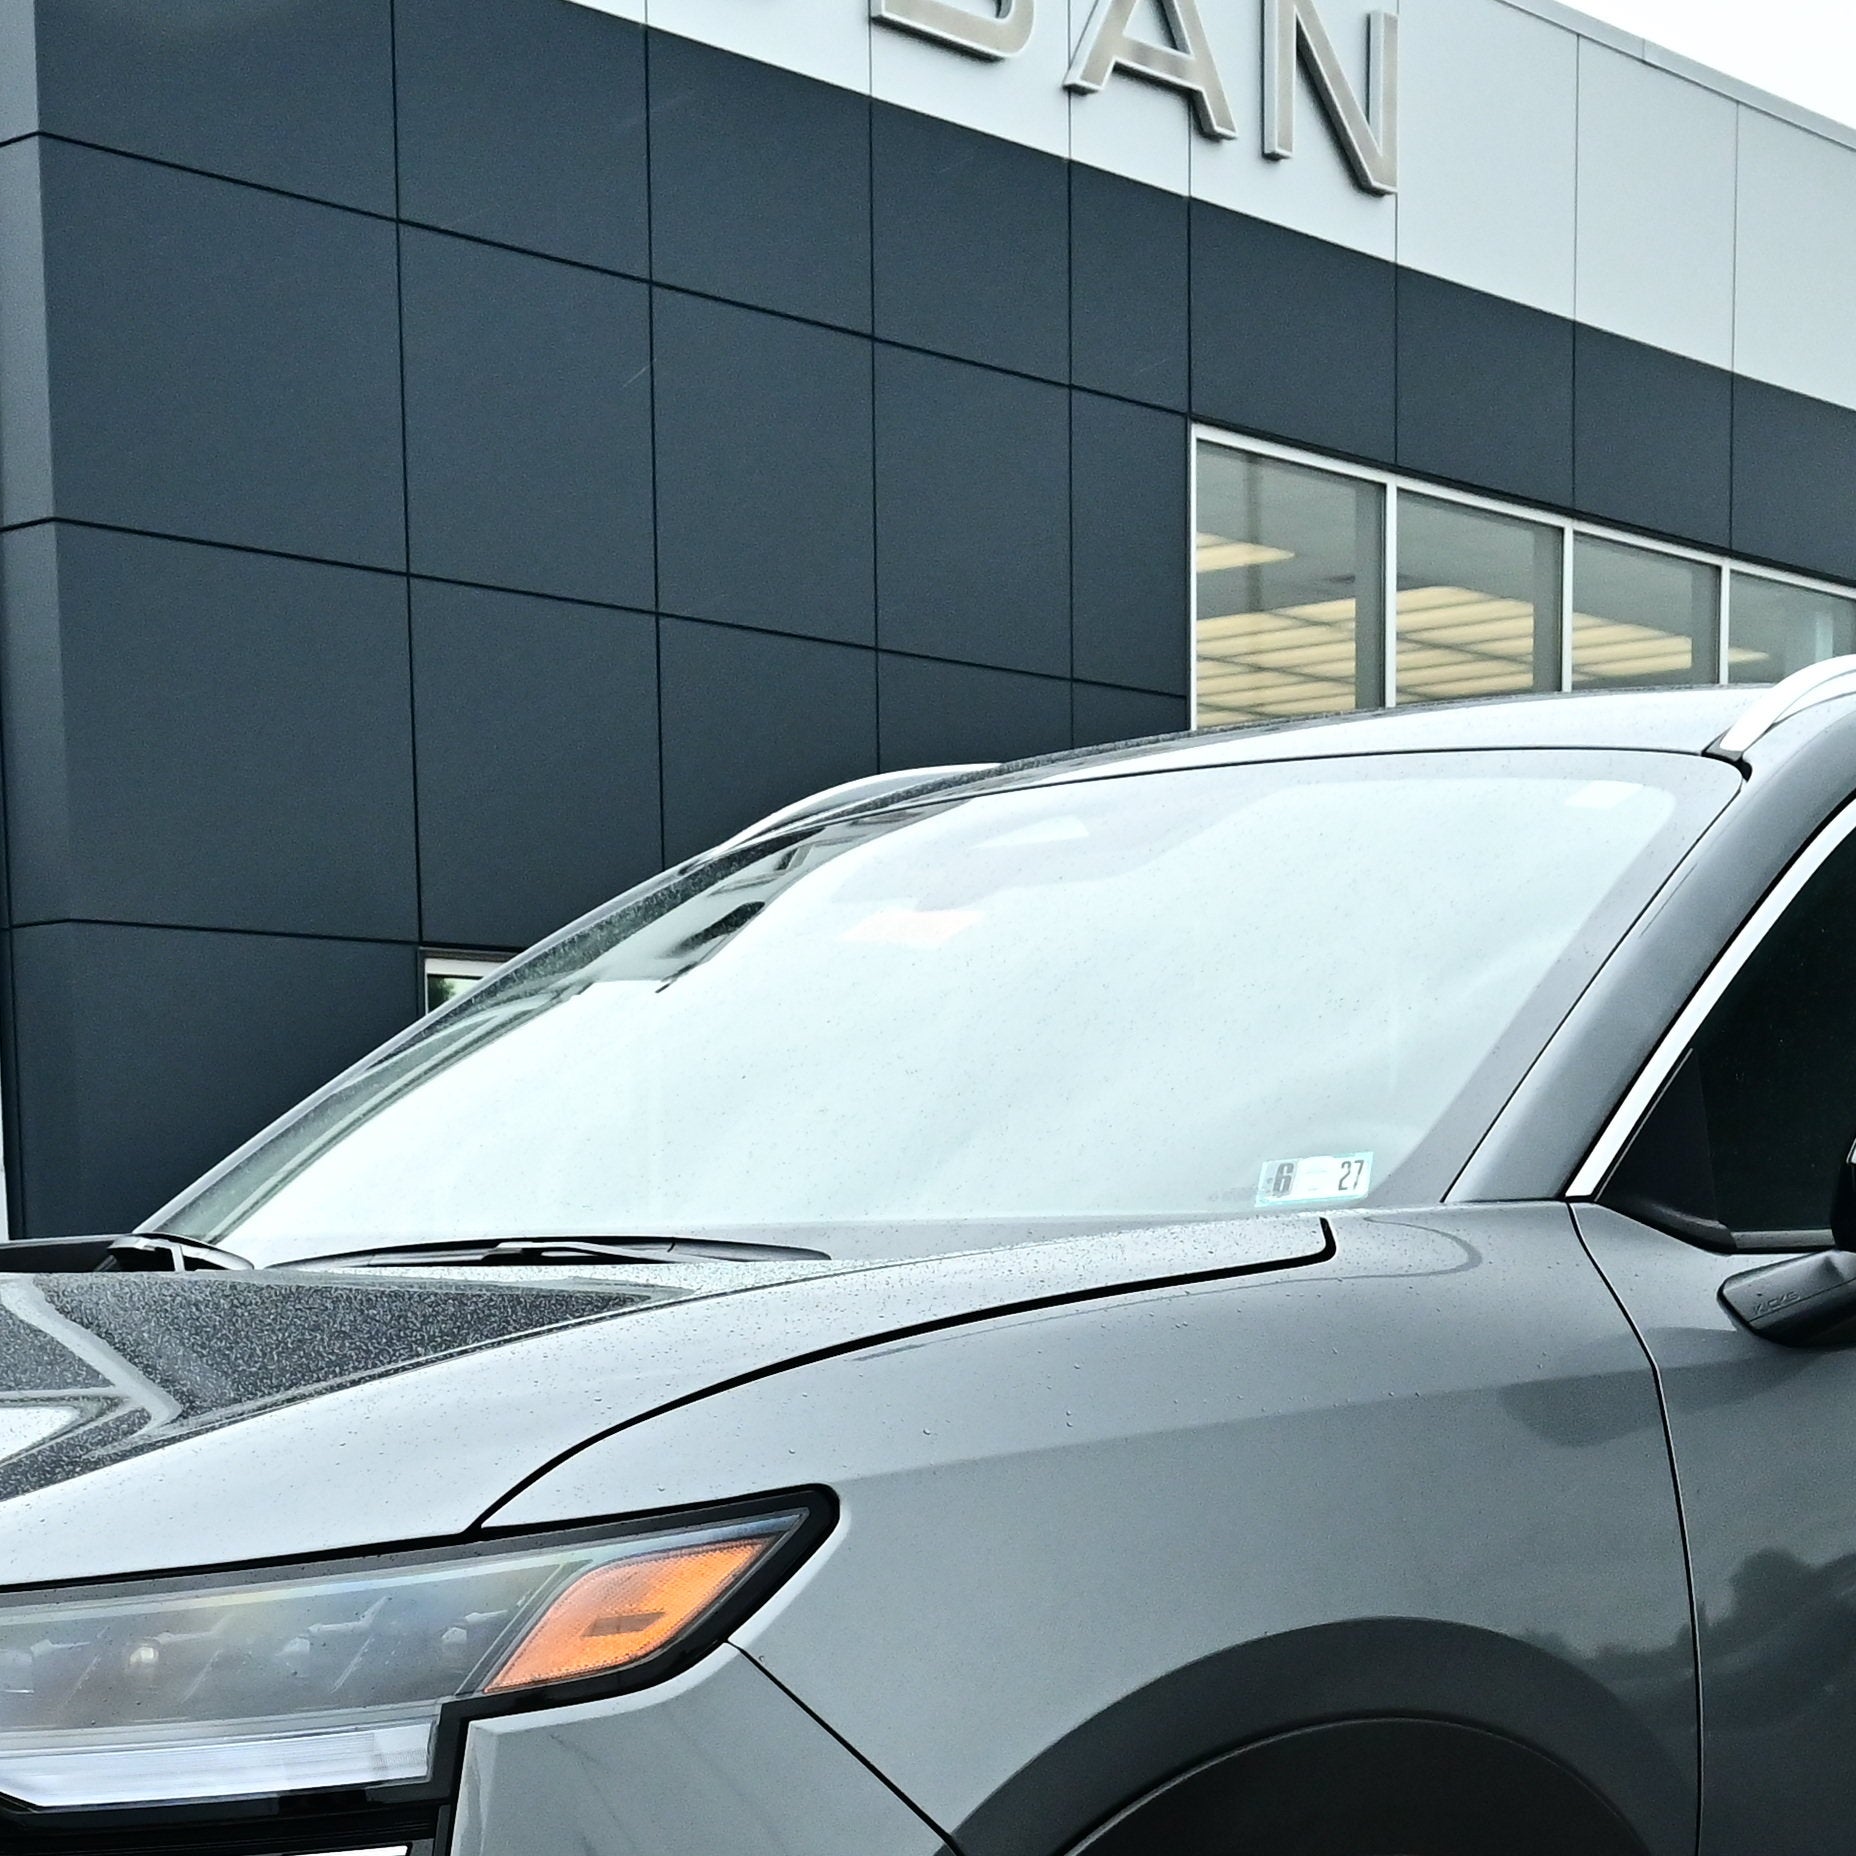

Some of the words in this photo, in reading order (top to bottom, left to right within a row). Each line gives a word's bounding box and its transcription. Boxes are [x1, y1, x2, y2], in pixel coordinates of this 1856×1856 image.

[869, 0, 1398, 195] AN
[1272, 1162, 1294, 1197] 6
[1338, 1159, 1364, 1191] 27
